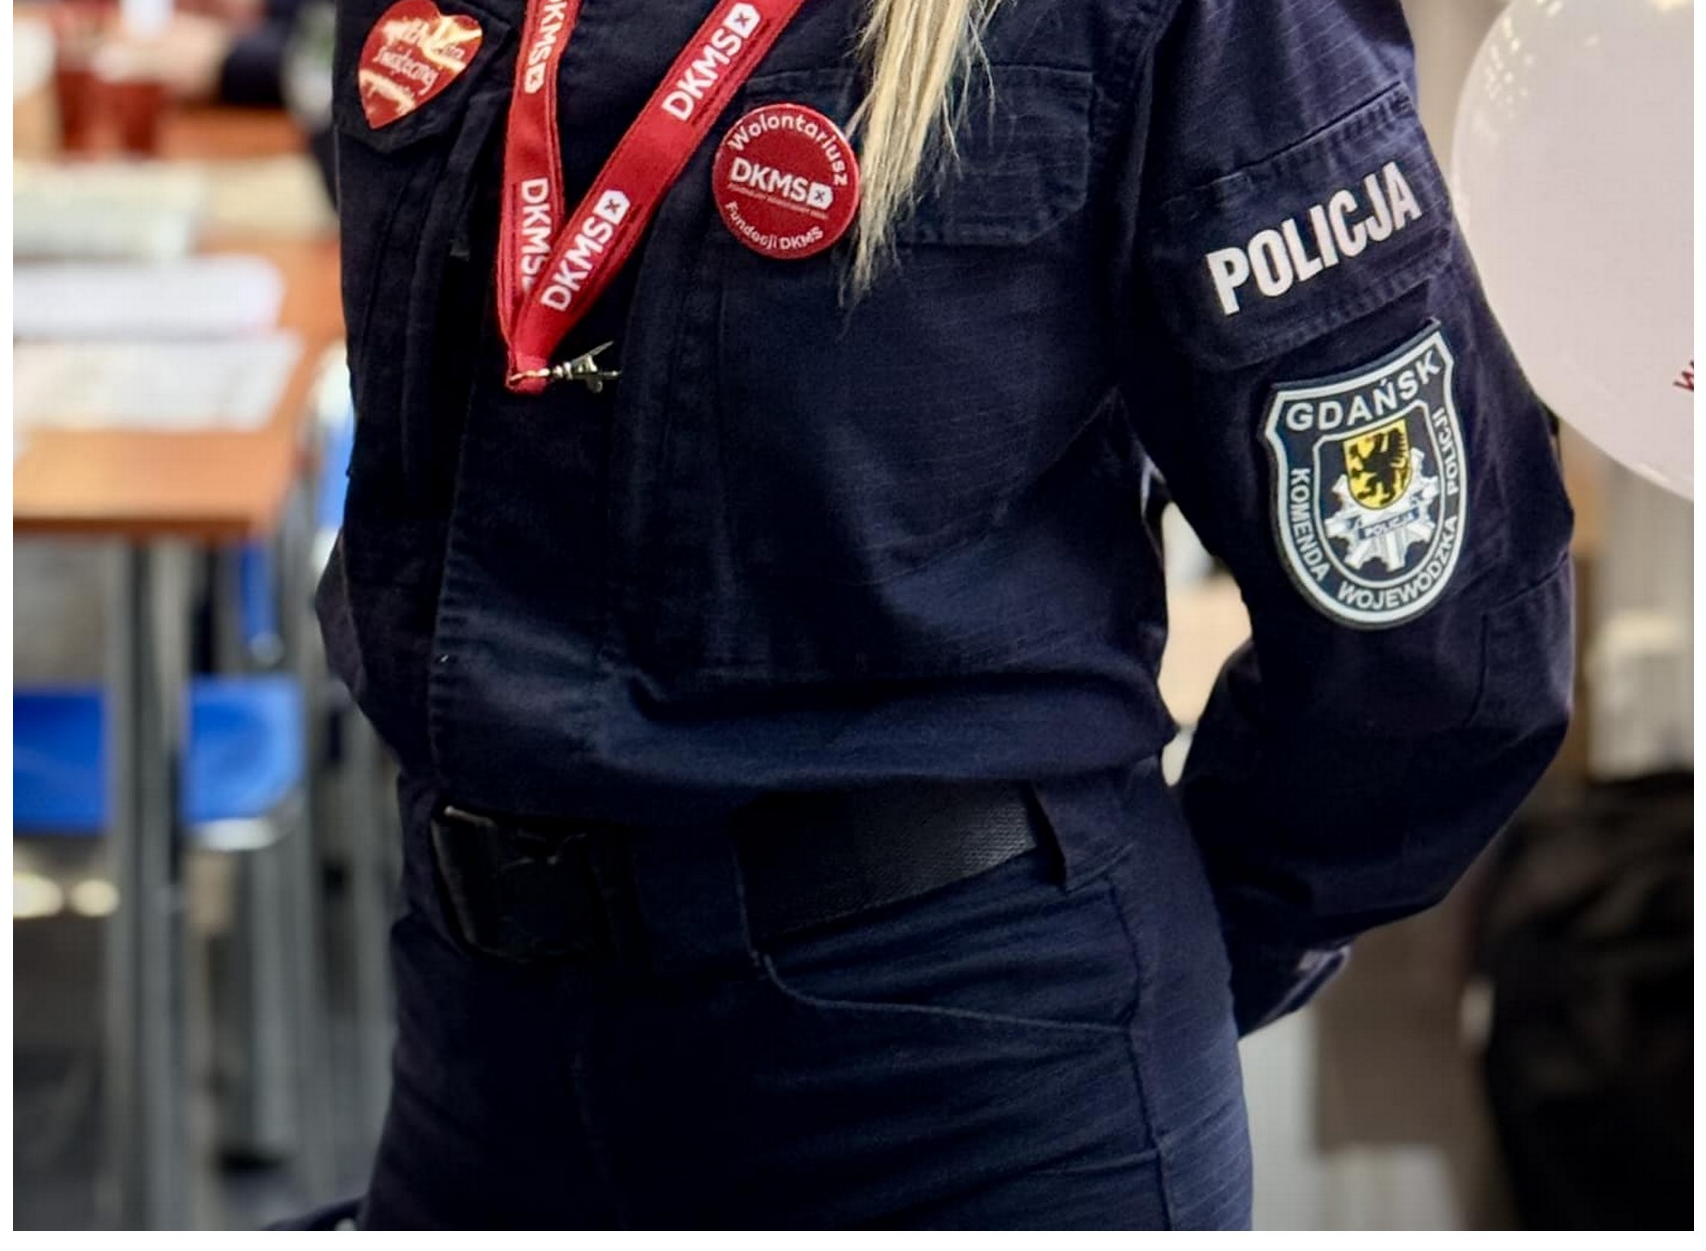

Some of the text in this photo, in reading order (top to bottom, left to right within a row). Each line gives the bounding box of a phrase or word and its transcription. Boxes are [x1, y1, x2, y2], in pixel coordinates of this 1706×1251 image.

[661, 30, 742, 121] DKMS
[727, 114, 848, 186] Wolontariusz
[730, 157, 809, 202] DKMS
[540, 216, 614, 311] DKMS
[779, 226, 824, 250] DKMS
[1205, 161, 1423, 316] POLICJA
[1286, 350, 1441, 432] GDAŃSK
[1290, 468, 1331, 583] KOMENDA
[1432, 408, 1459, 496] POLICJI
